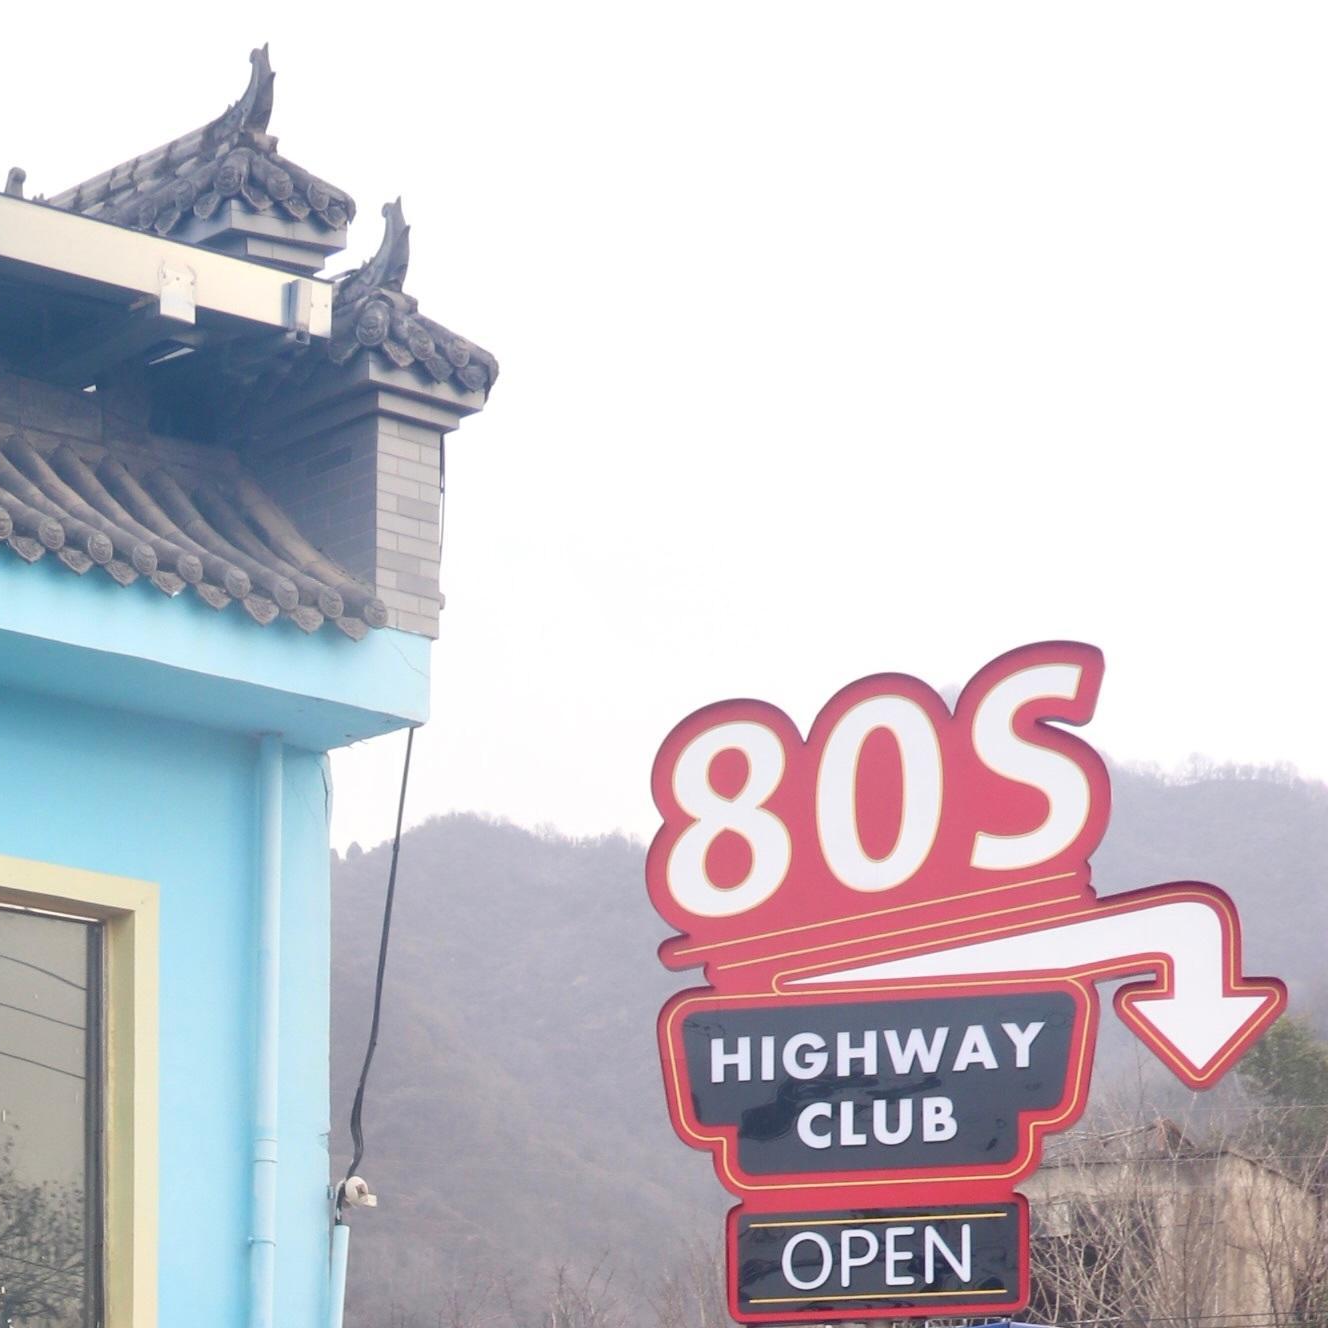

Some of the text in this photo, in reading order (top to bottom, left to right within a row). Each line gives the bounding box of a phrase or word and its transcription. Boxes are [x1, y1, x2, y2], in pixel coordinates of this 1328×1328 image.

[667, 662, 1091, 918] 80S
[709, 1021, 1046, 1083] HIGHWAY
[796, 1096, 959, 1149] CLUB
[781, 1223, 972, 1291] OPEN
